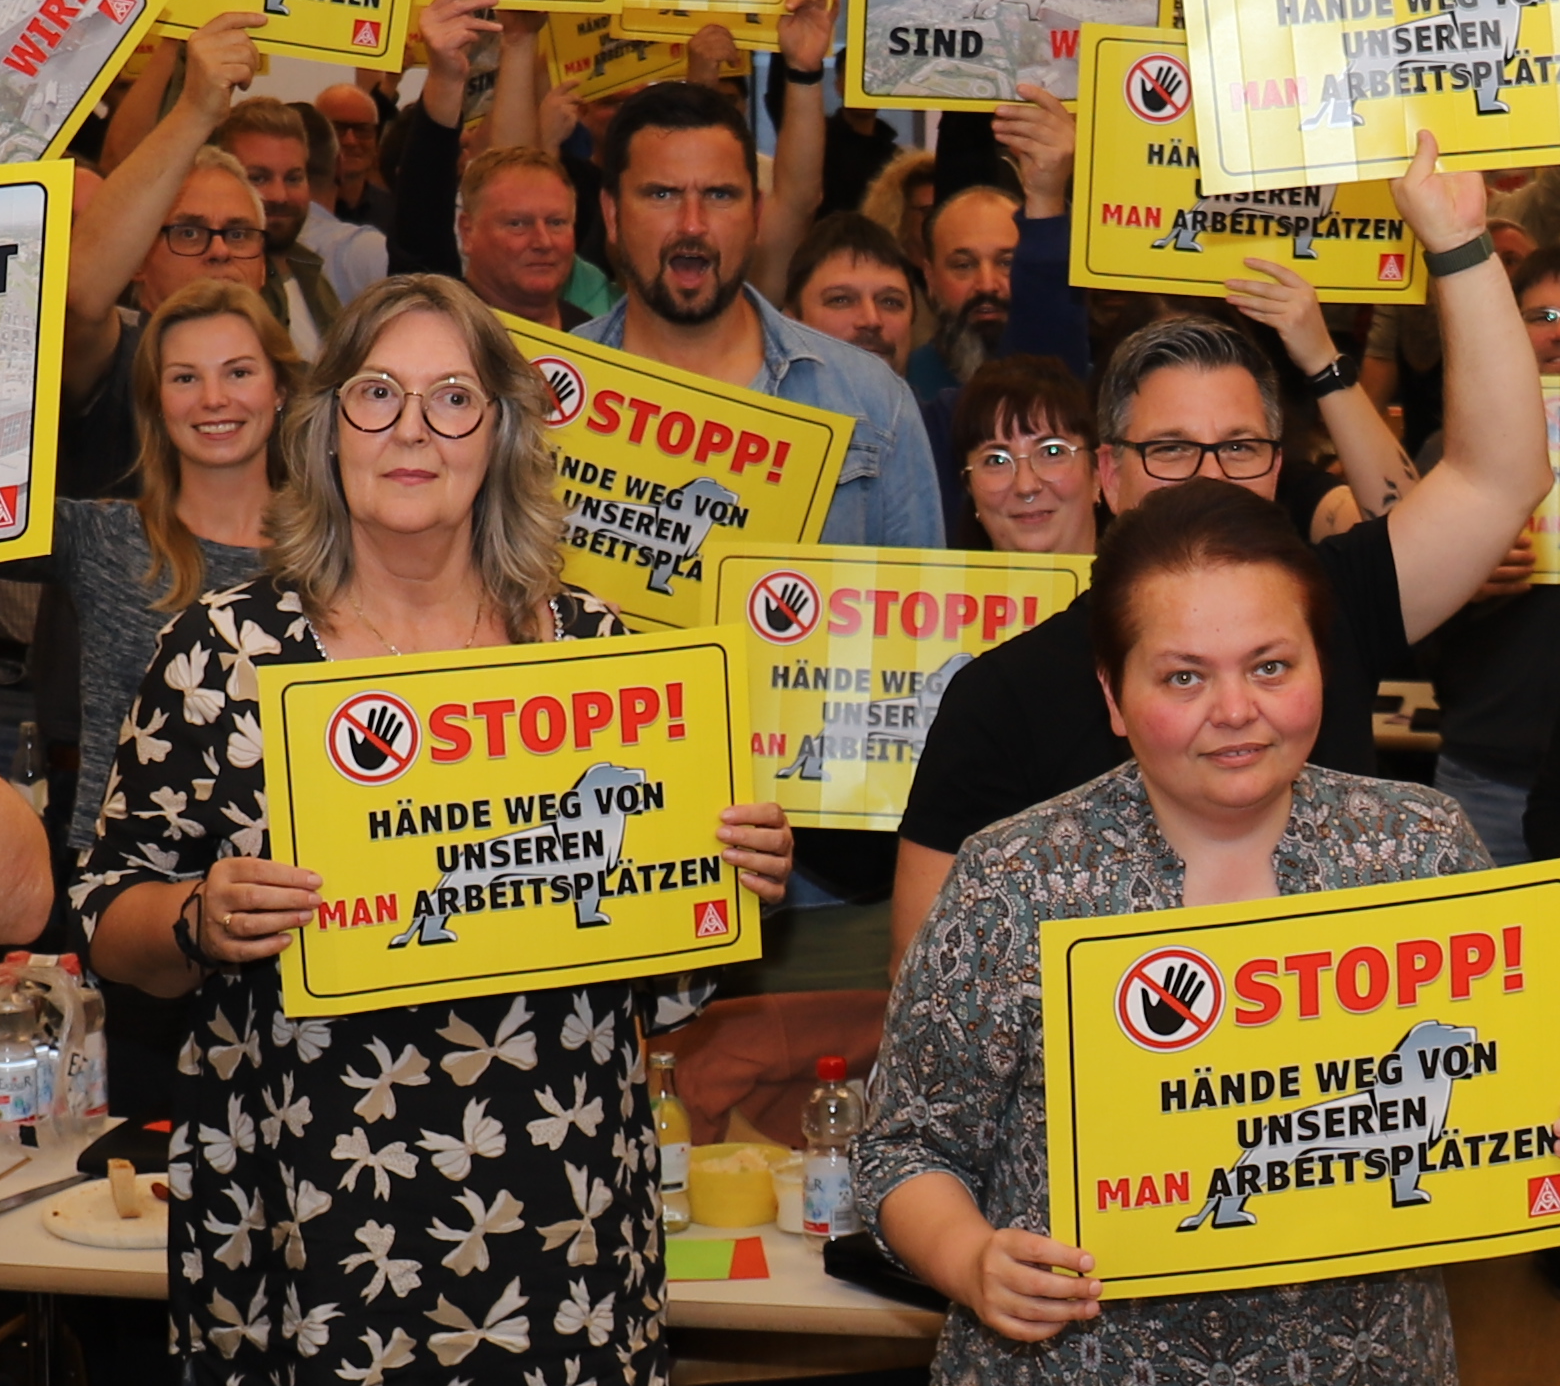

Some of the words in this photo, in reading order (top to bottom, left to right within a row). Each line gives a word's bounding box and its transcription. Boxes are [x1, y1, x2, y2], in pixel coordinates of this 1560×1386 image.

[889, 26, 984, 59] SIND
[1342, 18, 1503, 59] UNSEREN
[1230, 77, 1309, 112] MAN
[1101, 203, 1163, 229] MAN
[1172, 208, 1405, 242] ARBEITSPLÄTZEN
[586, 389, 793, 485] STOPP!
[563, 489, 692, 546] UNSEREN
[624, 474, 685, 511] WEG
[694, 494, 750, 530] VON
[827, 588, 1039, 642] STOPP!
[771, 659, 872, 694] HÄNDE
[881, 670, 944, 695] WEG
[428, 681, 687, 765] STOPP!
[368, 799, 492, 841] HÄNDE
[504, 790, 583, 825] WEG
[594, 780, 666, 817] VON
[436, 828, 605, 874] UNSEREN
[317, 893, 400, 931] MAN
[412, 854, 722, 921] ARBEITSPLÄTZEN
[1233, 924, 1526, 1027] STOPP!
[1159, 1066, 1301, 1114] HÄNDE
[1315, 1051, 1404, 1094] WEG
[1416, 1039, 1498, 1081] VON
[1236, 1095, 1427, 1149] UNSEREN
[1096, 1170, 1191, 1212] MAN
[1205, 1123, 1558, 1201] ARBEITSPLÄTZEN
